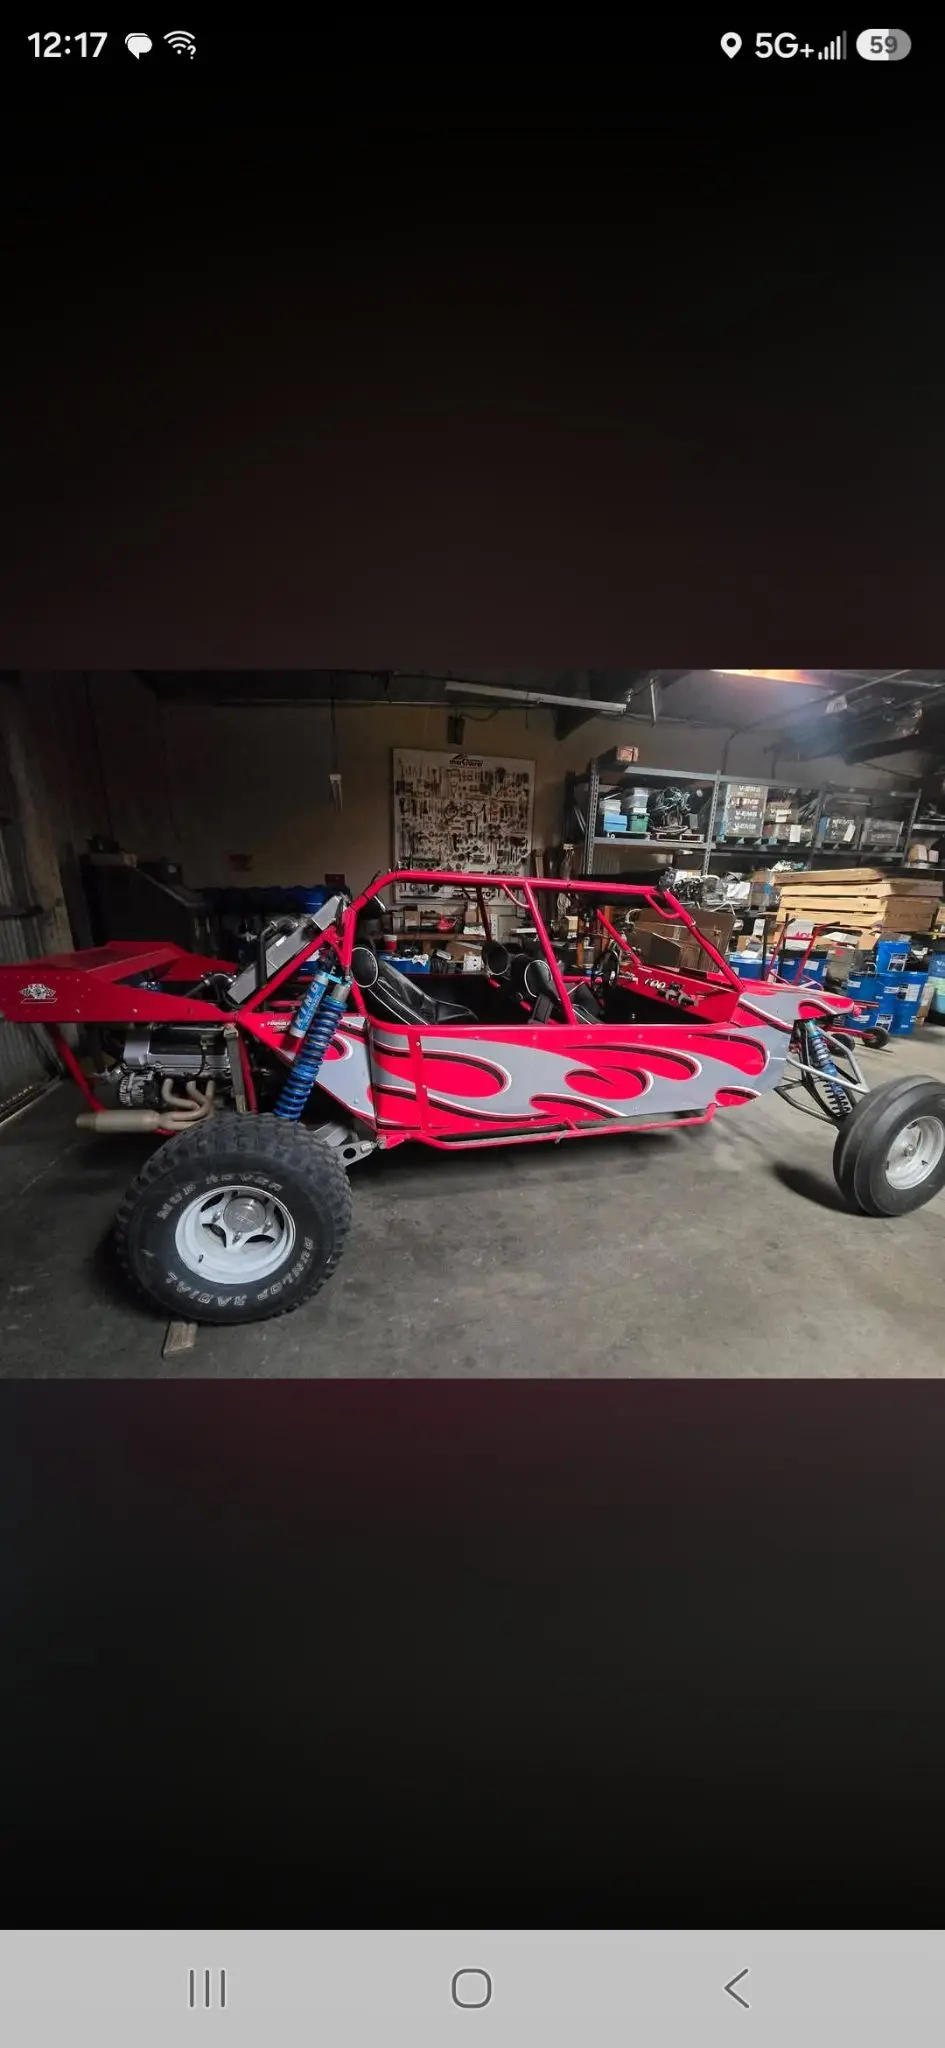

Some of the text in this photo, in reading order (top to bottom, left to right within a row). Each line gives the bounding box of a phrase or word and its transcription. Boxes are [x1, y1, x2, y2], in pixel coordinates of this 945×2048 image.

[157, 1173, 283, 1219] MUD ROVER
[166, 1237, 314, 1307] DUNLOP RADIAL
